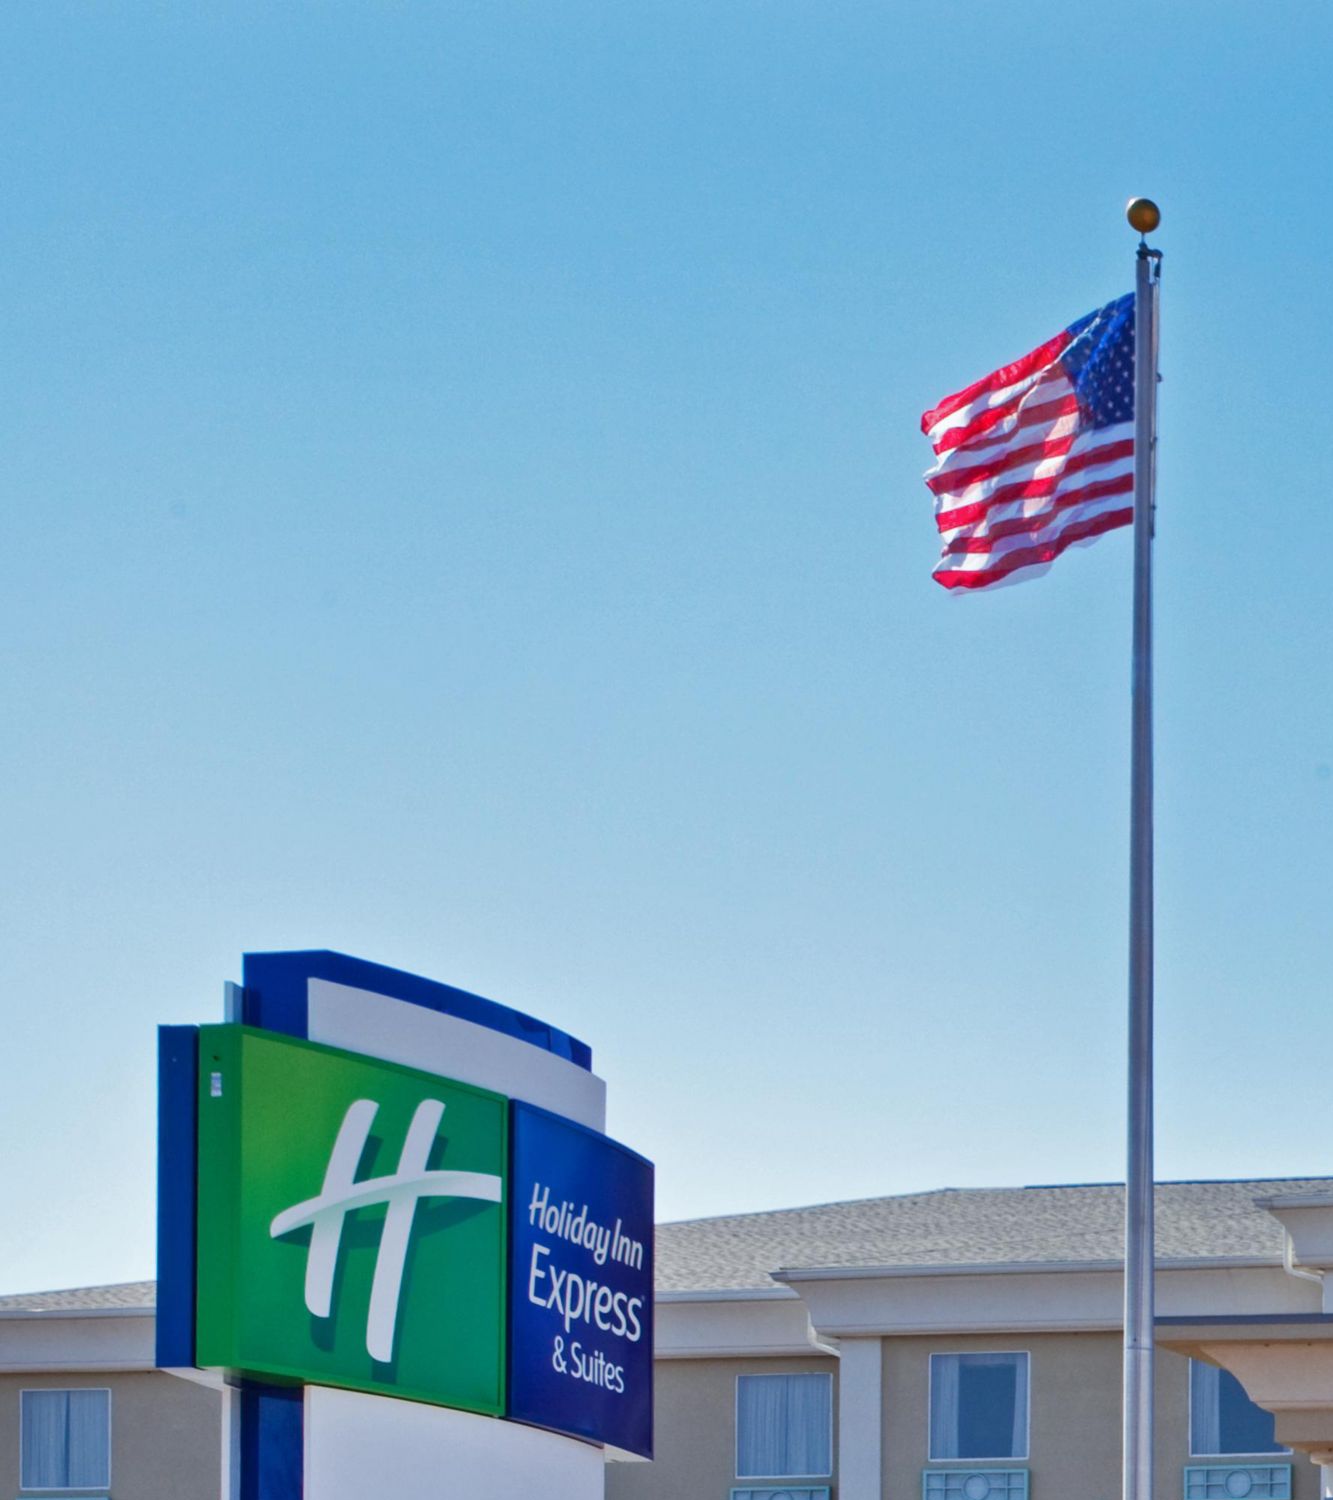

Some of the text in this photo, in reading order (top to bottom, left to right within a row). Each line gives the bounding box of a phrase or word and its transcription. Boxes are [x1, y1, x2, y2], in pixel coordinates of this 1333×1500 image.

[528, 1182, 644, 1271] Holiday Inn
[528, 1242, 643, 1342] Express
[552, 1335, 625, 1394] & Suites
